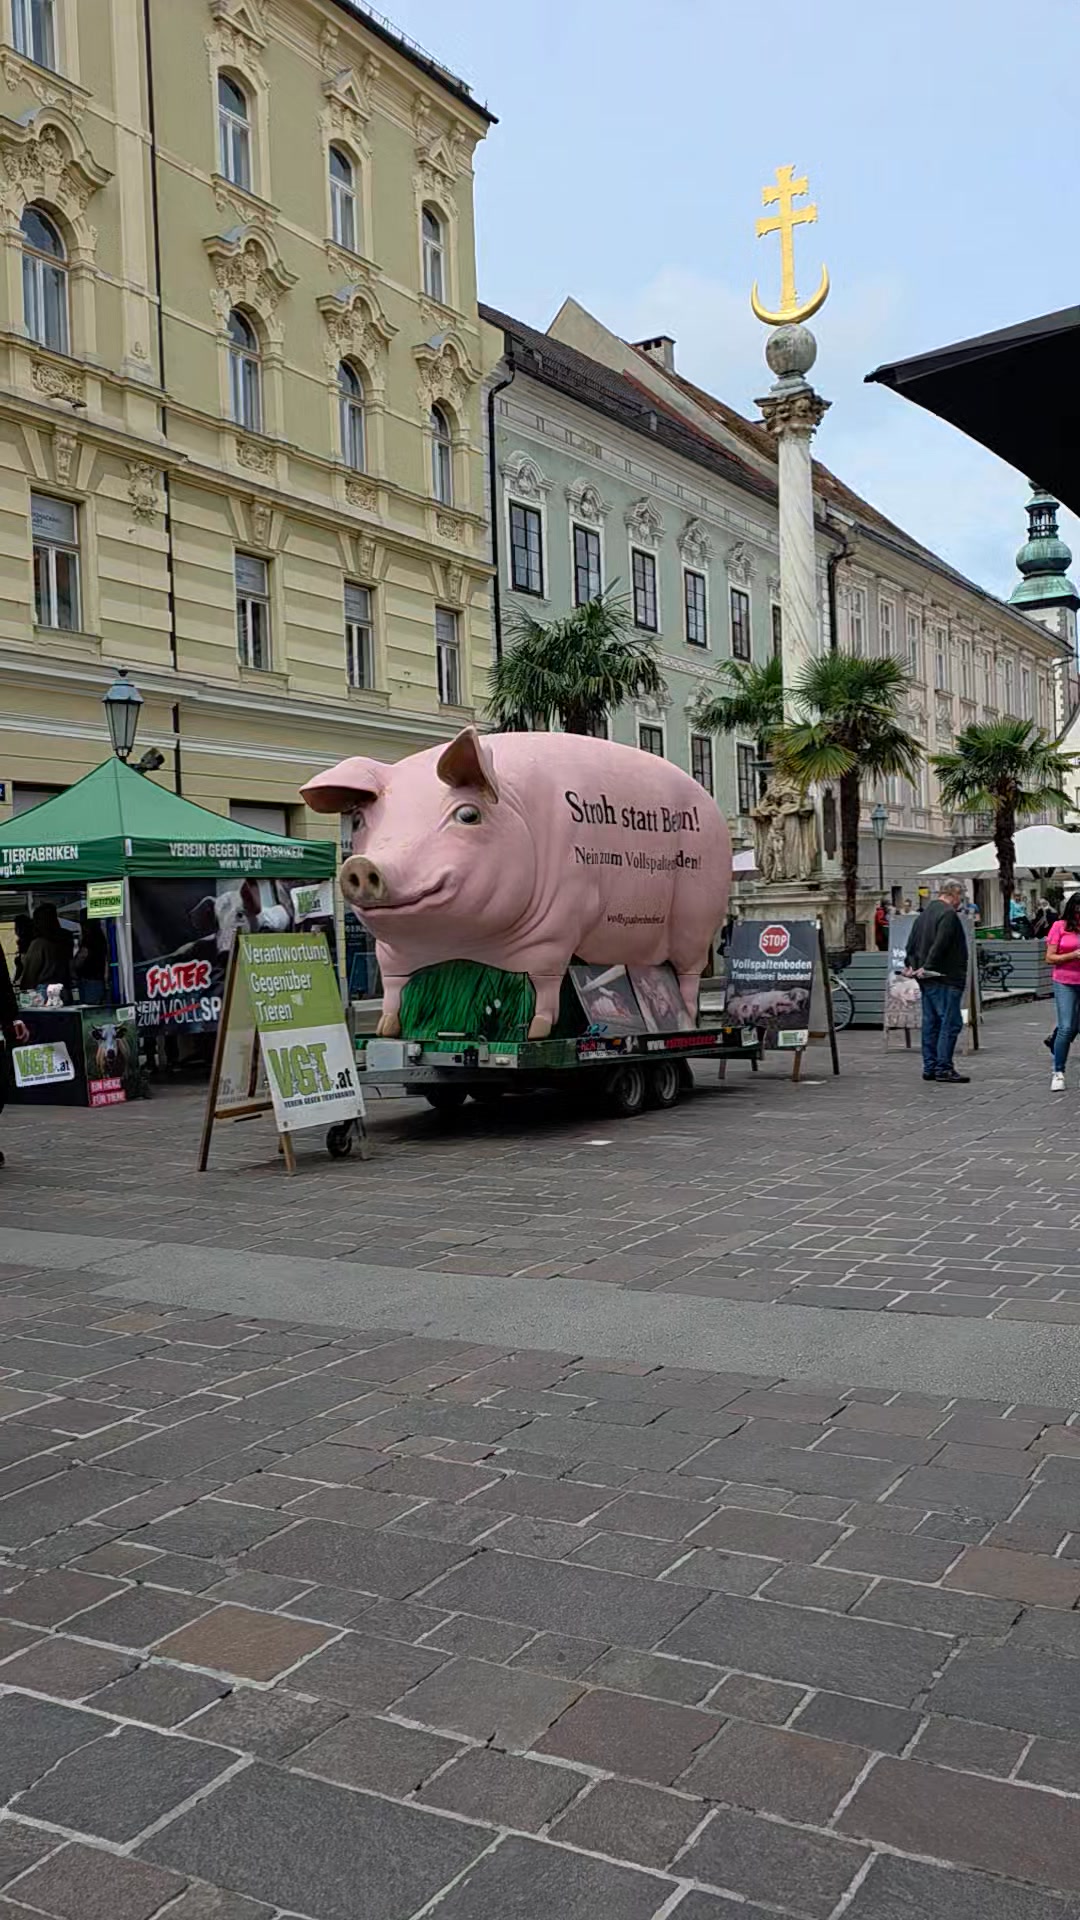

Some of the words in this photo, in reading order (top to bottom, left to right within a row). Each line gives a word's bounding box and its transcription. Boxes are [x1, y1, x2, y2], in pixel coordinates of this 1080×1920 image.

[565, 790, 617, 824] Stroh
[621, 806, 658, 832] statt
[2, 845, 79, 864] TIERFABRIKEN
[169, 842, 206, 858] VEREIN
[208, 843, 240, 858] GEGEN
[241, 844, 304, 859] TIERFABRIKEN
[574, 846, 598, 865] Nein
[599, 853, 622, 866] zum
[219, 859, 262, 871] www.vgt.at
[90, 895, 121, 908] PETITION
[761, 934, 787, 947] STOP
[243, 943, 330, 966] Verantwortung
[732, 958, 813, 971] Vollspaltenboden
[147, 960, 211, 997] FOLTER
[250, 968, 312, 998] Gegenüber
[137, 1012, 160, 1027] ZUM
[255, 1001, 293, 1023] Tieren
[14, 1045, 70, 1077] VGT.at
[268, 1043, 353, 1099] VGT.at
